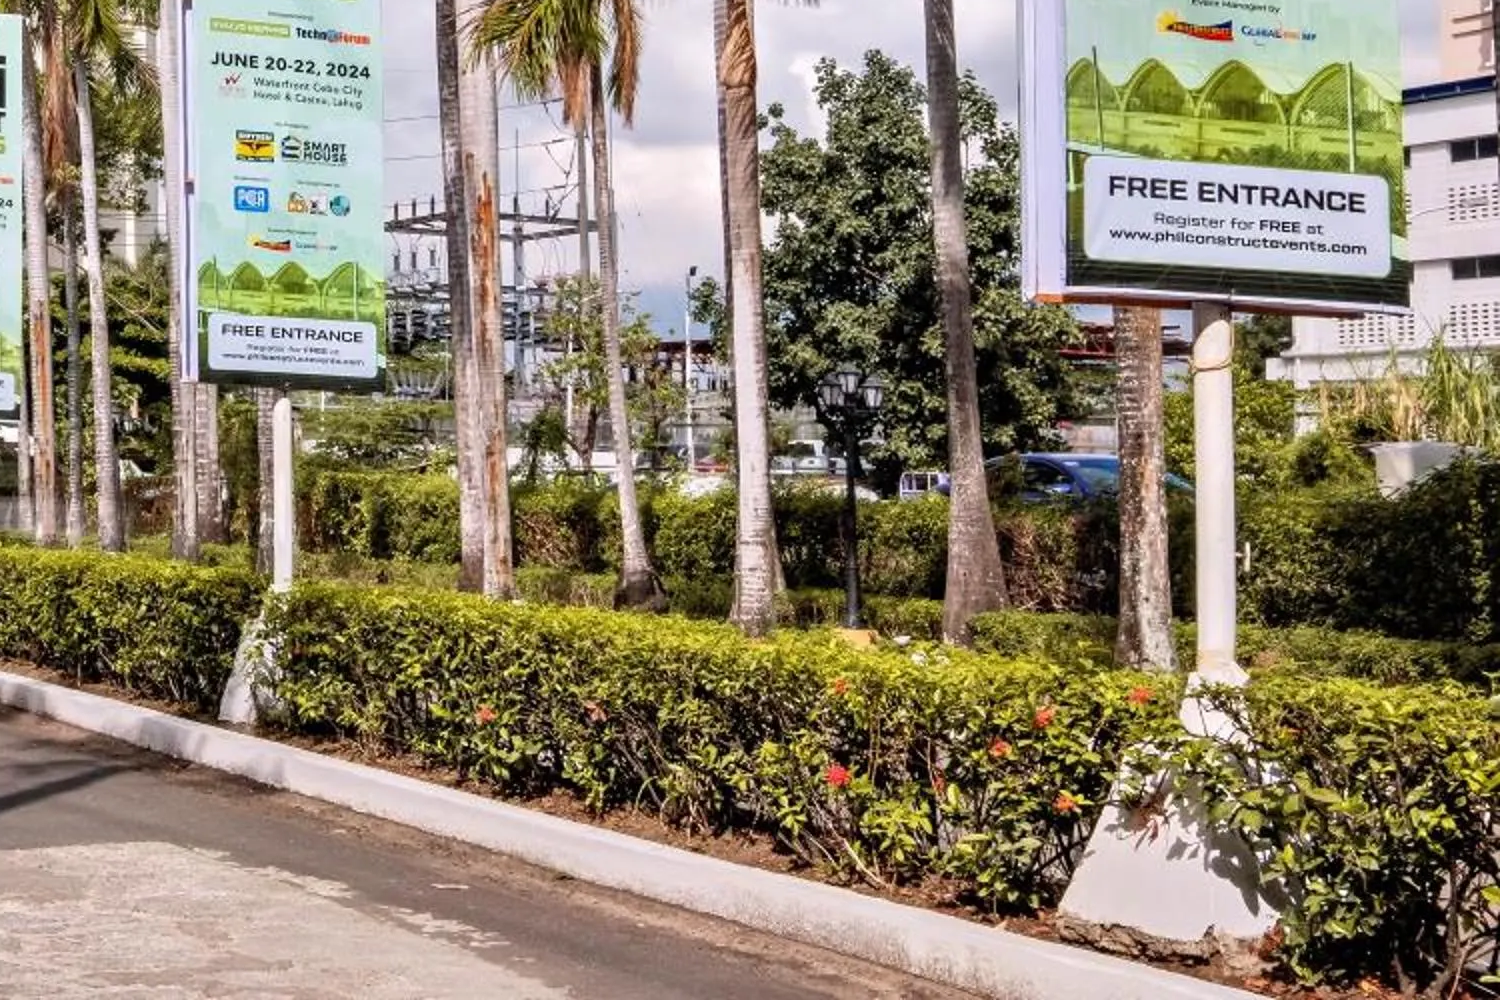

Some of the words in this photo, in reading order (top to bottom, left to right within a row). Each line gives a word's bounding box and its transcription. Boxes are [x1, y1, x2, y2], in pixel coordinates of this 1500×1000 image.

[211, 51, 259, 69] JUNE
[265, 56, 321, 77] 20-22,
[325, 62, 371, 79] 2024
[302, 140, 347, 153] SMART
[303, 151, 347, 163] HOUSE
[1109, 175, 1188, 201] FREE
[1198, 181, 1367, 214] ENTRANCE
[1154, 211, 1225, 231] Register
[1230, 217, 1256, 231] for
[1259, 218, 1301, 234] FREE
[1306, 224, 1324, 235] at
[1109, 228, 1368, 257] www.philconstructevents.com
[221, 323, 265, 338] FREE
[271, 326, 363, 343] ENTRANCE
